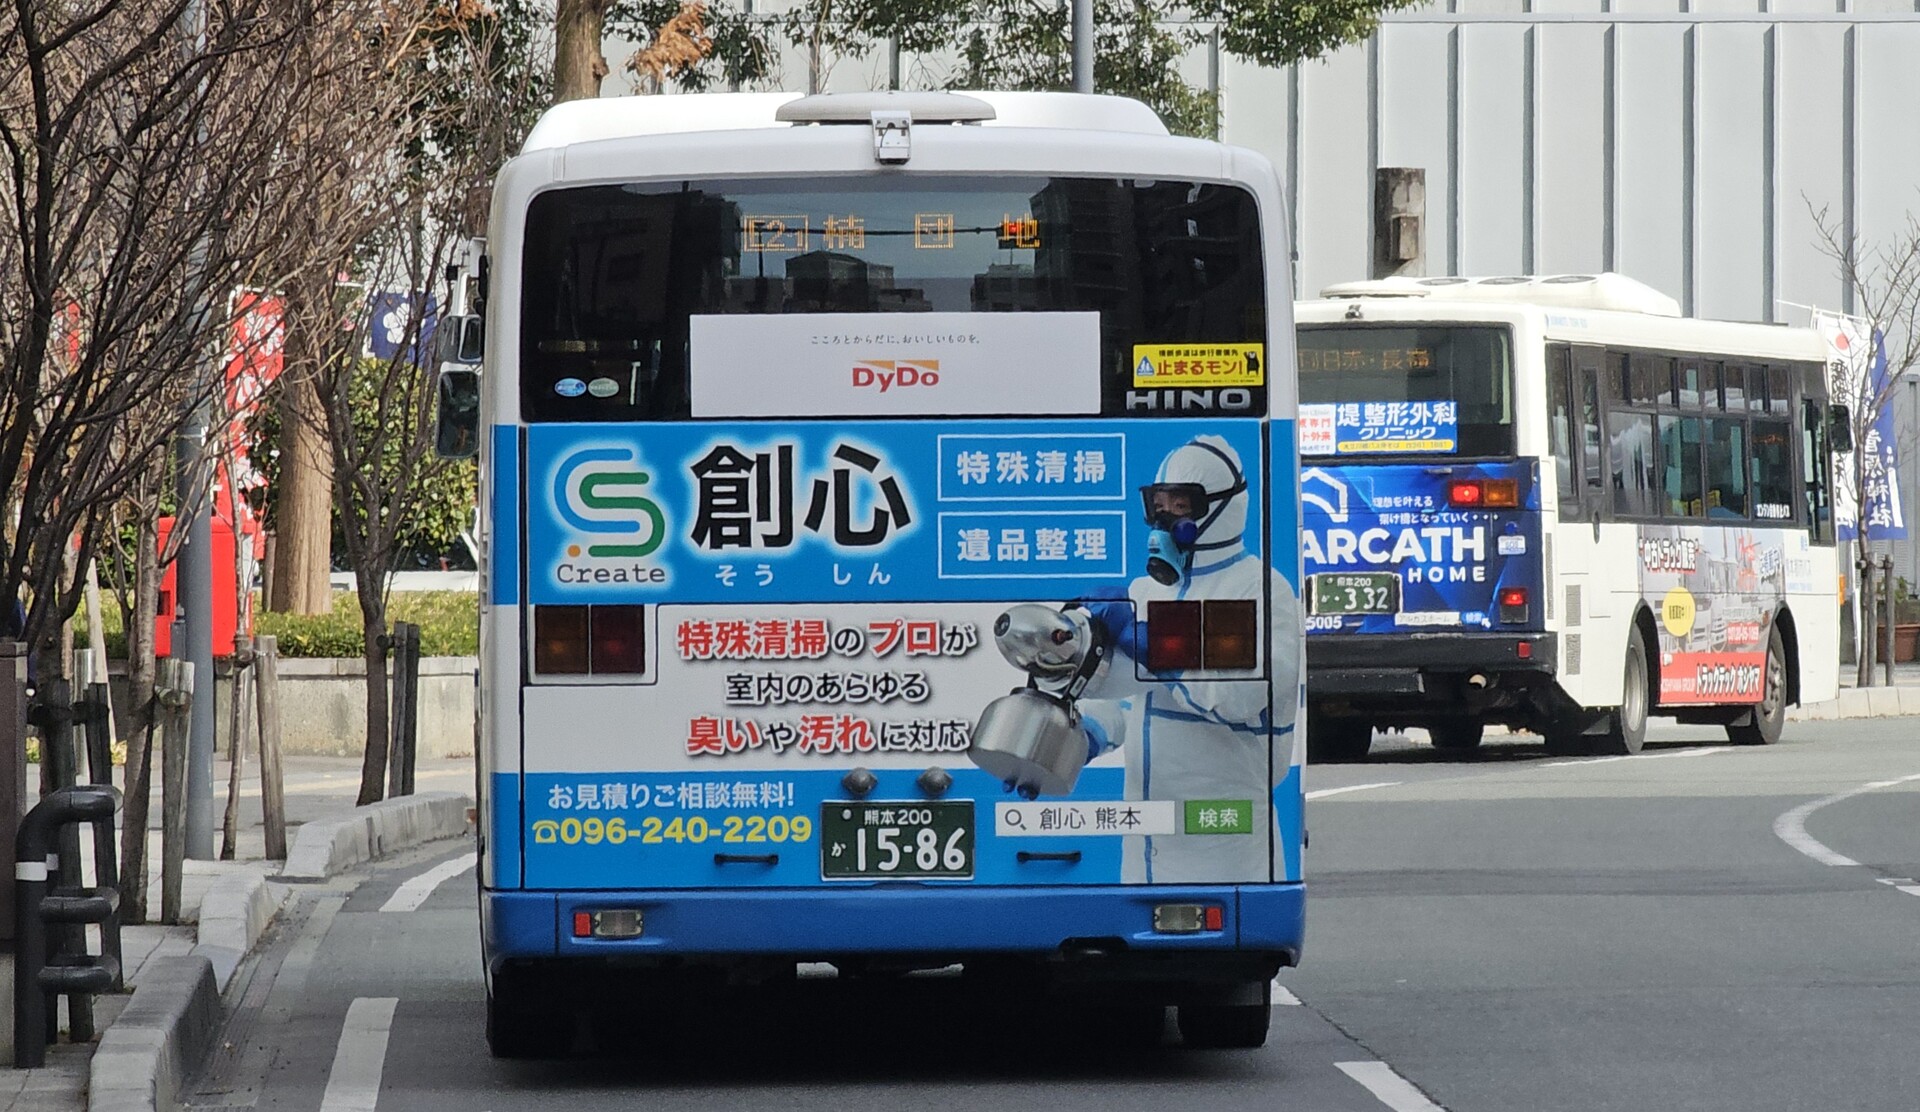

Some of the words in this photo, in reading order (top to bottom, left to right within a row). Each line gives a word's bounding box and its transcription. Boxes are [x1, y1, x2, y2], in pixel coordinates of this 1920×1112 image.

[811, 334, 981, 345] こころとからだに、おいしいものを。
[1156, 359, 1243, 376] 止まるモン!
[852, 367, 940, 393] DyDo
[1125, 389, 1252, 410] HINO
[1358, 427, 1436, 440] クリニック
[957, 450, 1107, 485] 特殊清掃
[690, 444, 912, 550] 創心
[1372, 496, 1433, 508] 理想を叶える
[957, 528, 1108, 562] 遺品整理
[556, 563, 666, 583] Create
[1407, 566, 1486, 583] HOME
[677, 618, 977, 657] 特殊清掃のプロが
[725, 672, 928, 703] 室内のあらゆる
[686, 715, 971, 753] 臭いや汚れに対応
[548, 781, 795, 810] お見積りご相談無料!
[1039, 807, 1087, 830] 創心
[1095, 807, 1142, 830] 熊本
[1197, 807, 1239, 828] 検索
[830, 841, 847, 858] か
[856, 827, 967, 872] 15-86
